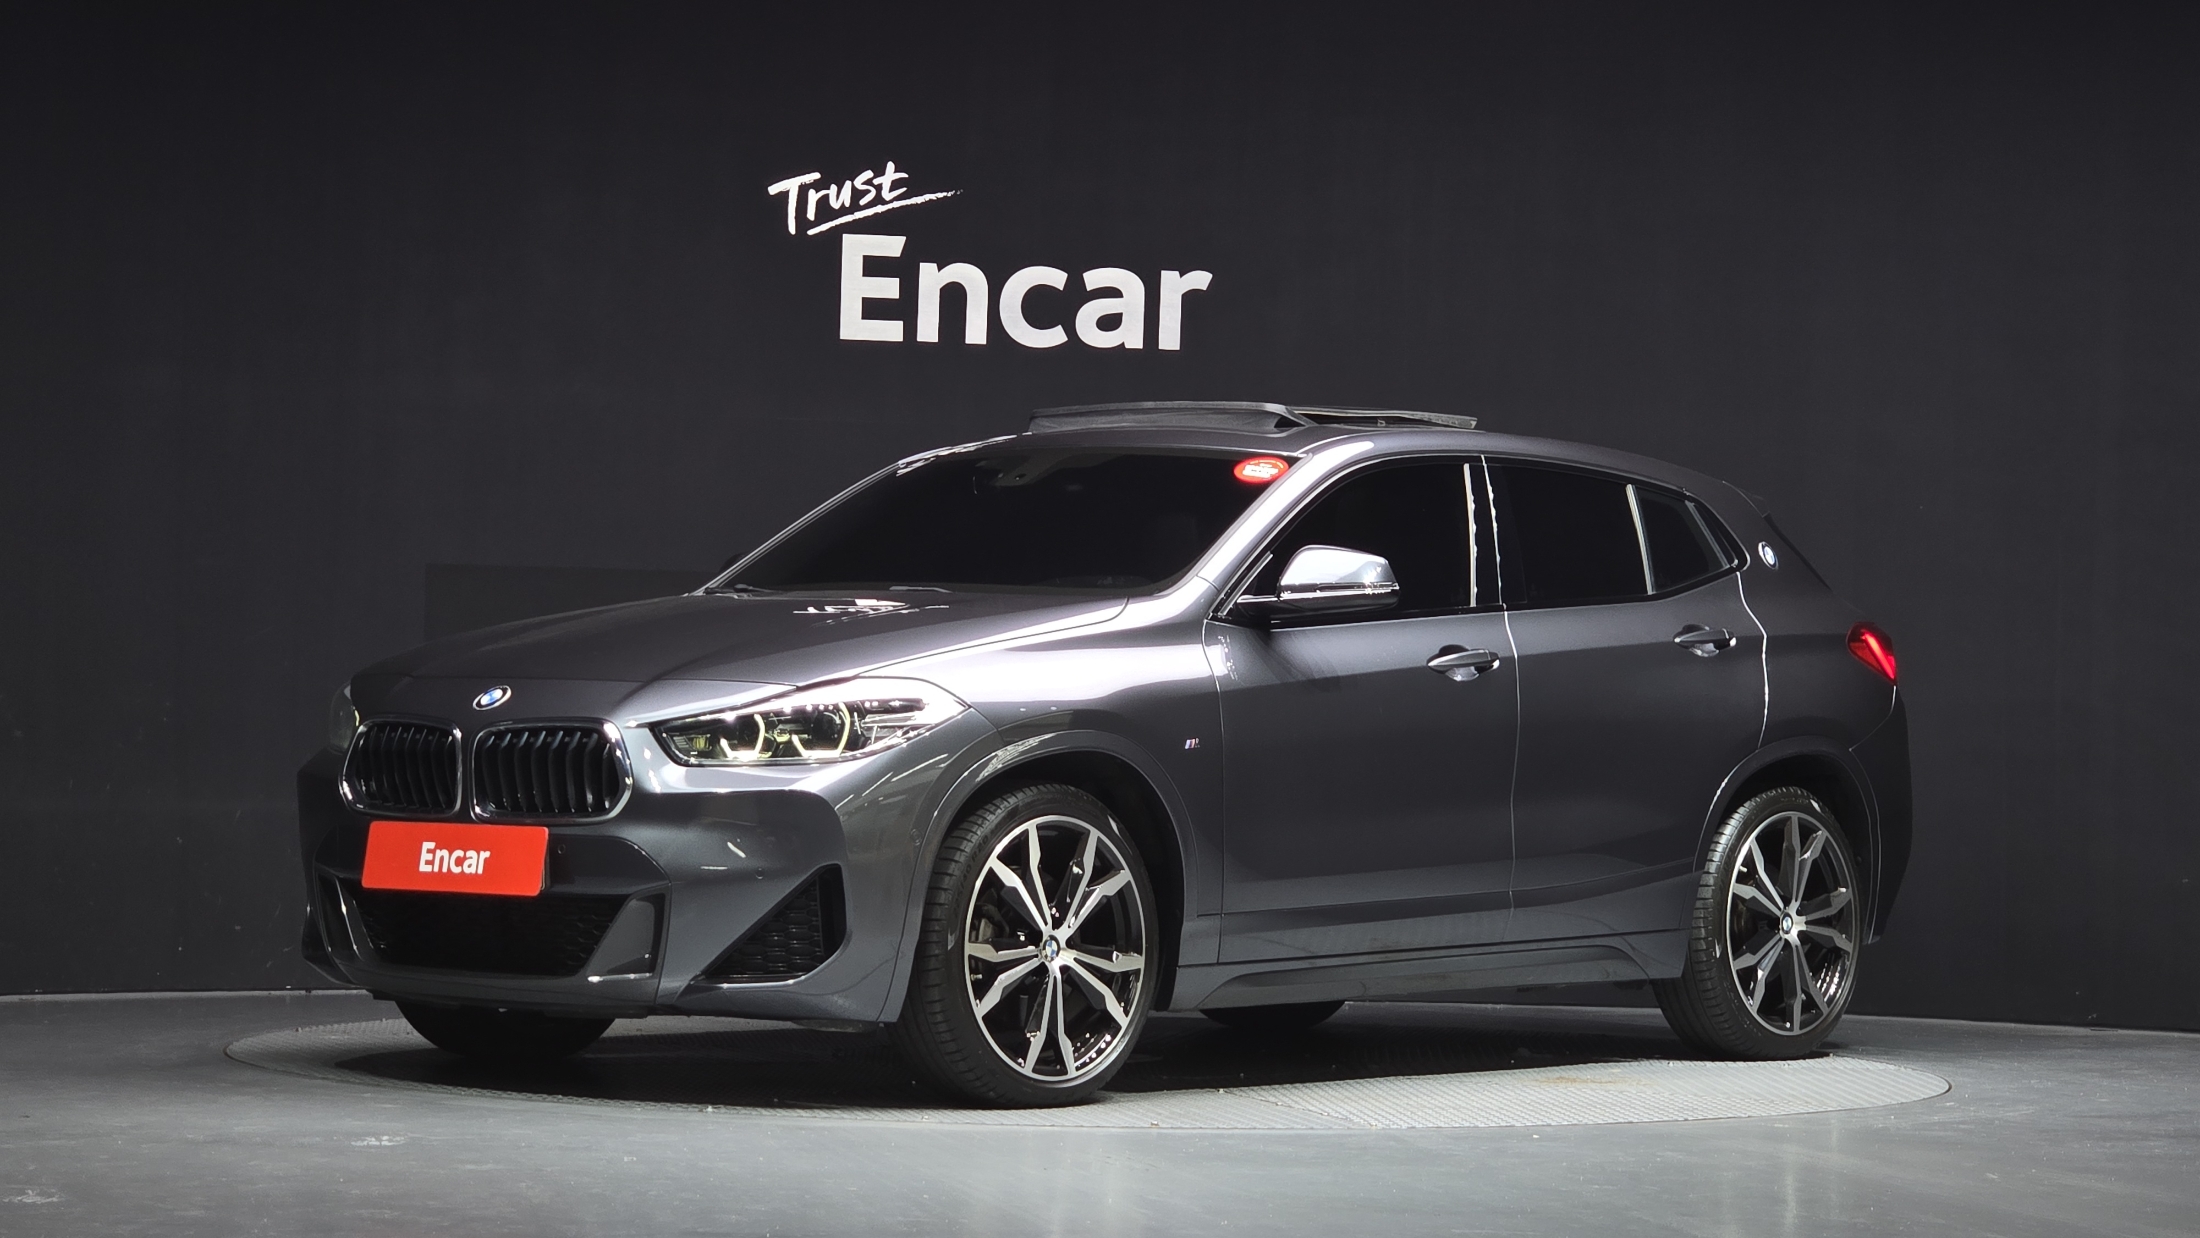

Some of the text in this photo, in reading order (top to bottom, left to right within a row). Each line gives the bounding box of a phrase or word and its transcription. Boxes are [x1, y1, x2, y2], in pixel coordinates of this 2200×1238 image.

[768, 161, 909, 236] Trust
[840, 233, 1213, 350] Encar
[419, 841, 491, 875] Encar
